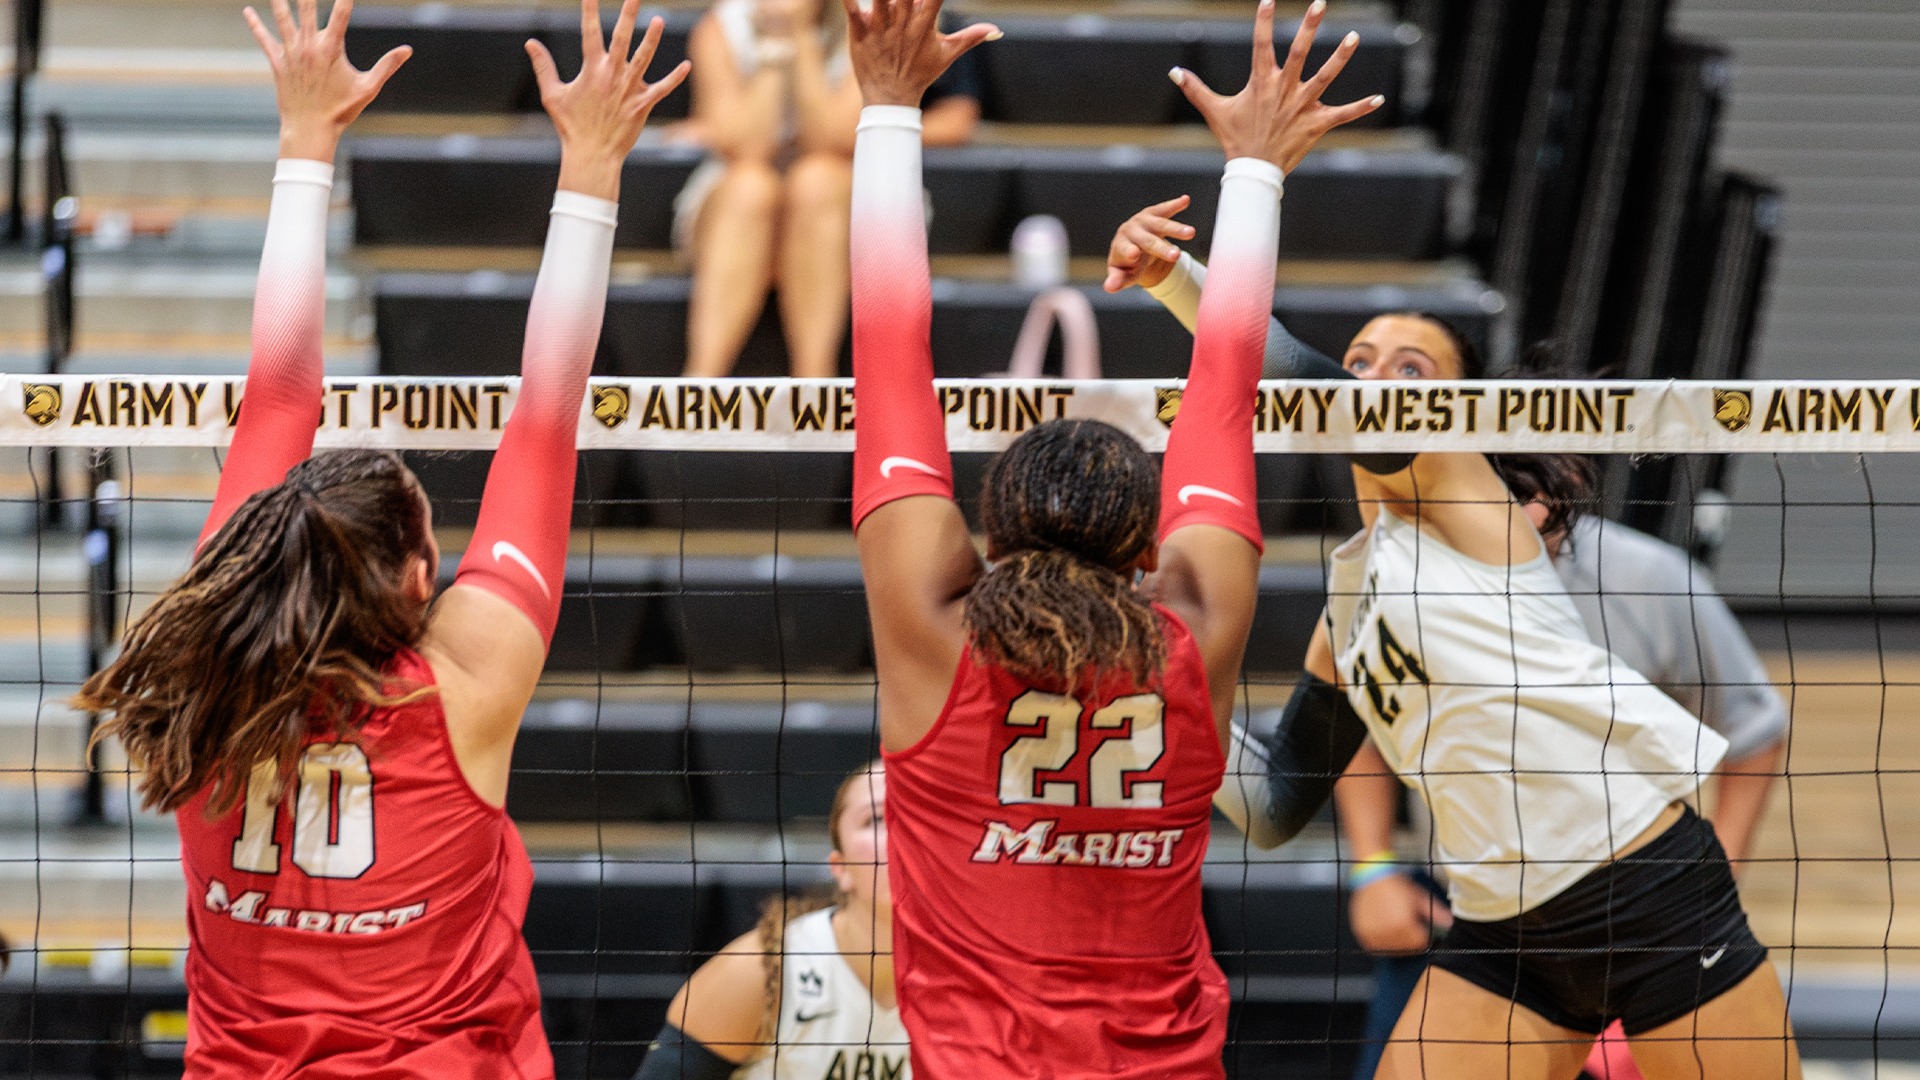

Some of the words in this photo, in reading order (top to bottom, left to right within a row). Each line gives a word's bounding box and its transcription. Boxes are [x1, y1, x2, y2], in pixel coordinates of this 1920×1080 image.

[71, 381, 208, 427] ARMY
[371, 384, 509, 430] POINT
[639, 384, 776, 431] ARMY
[790, 385, 855, 432] WE
[937, 386, 1075, 432] POINT
[1254, 386, 1339, 433] MY
[1352, 387, 1486, 433] WEST
[1761, 386, 1898, 433] ARMY
[1352, 613, 1430, 726] 24
[998, 688, 1166, 808] 22
[232, 742, 376, 879] 10
[968, 818, 1185, 869] MARIST
[824, 1048, 907, 1080] ARM
